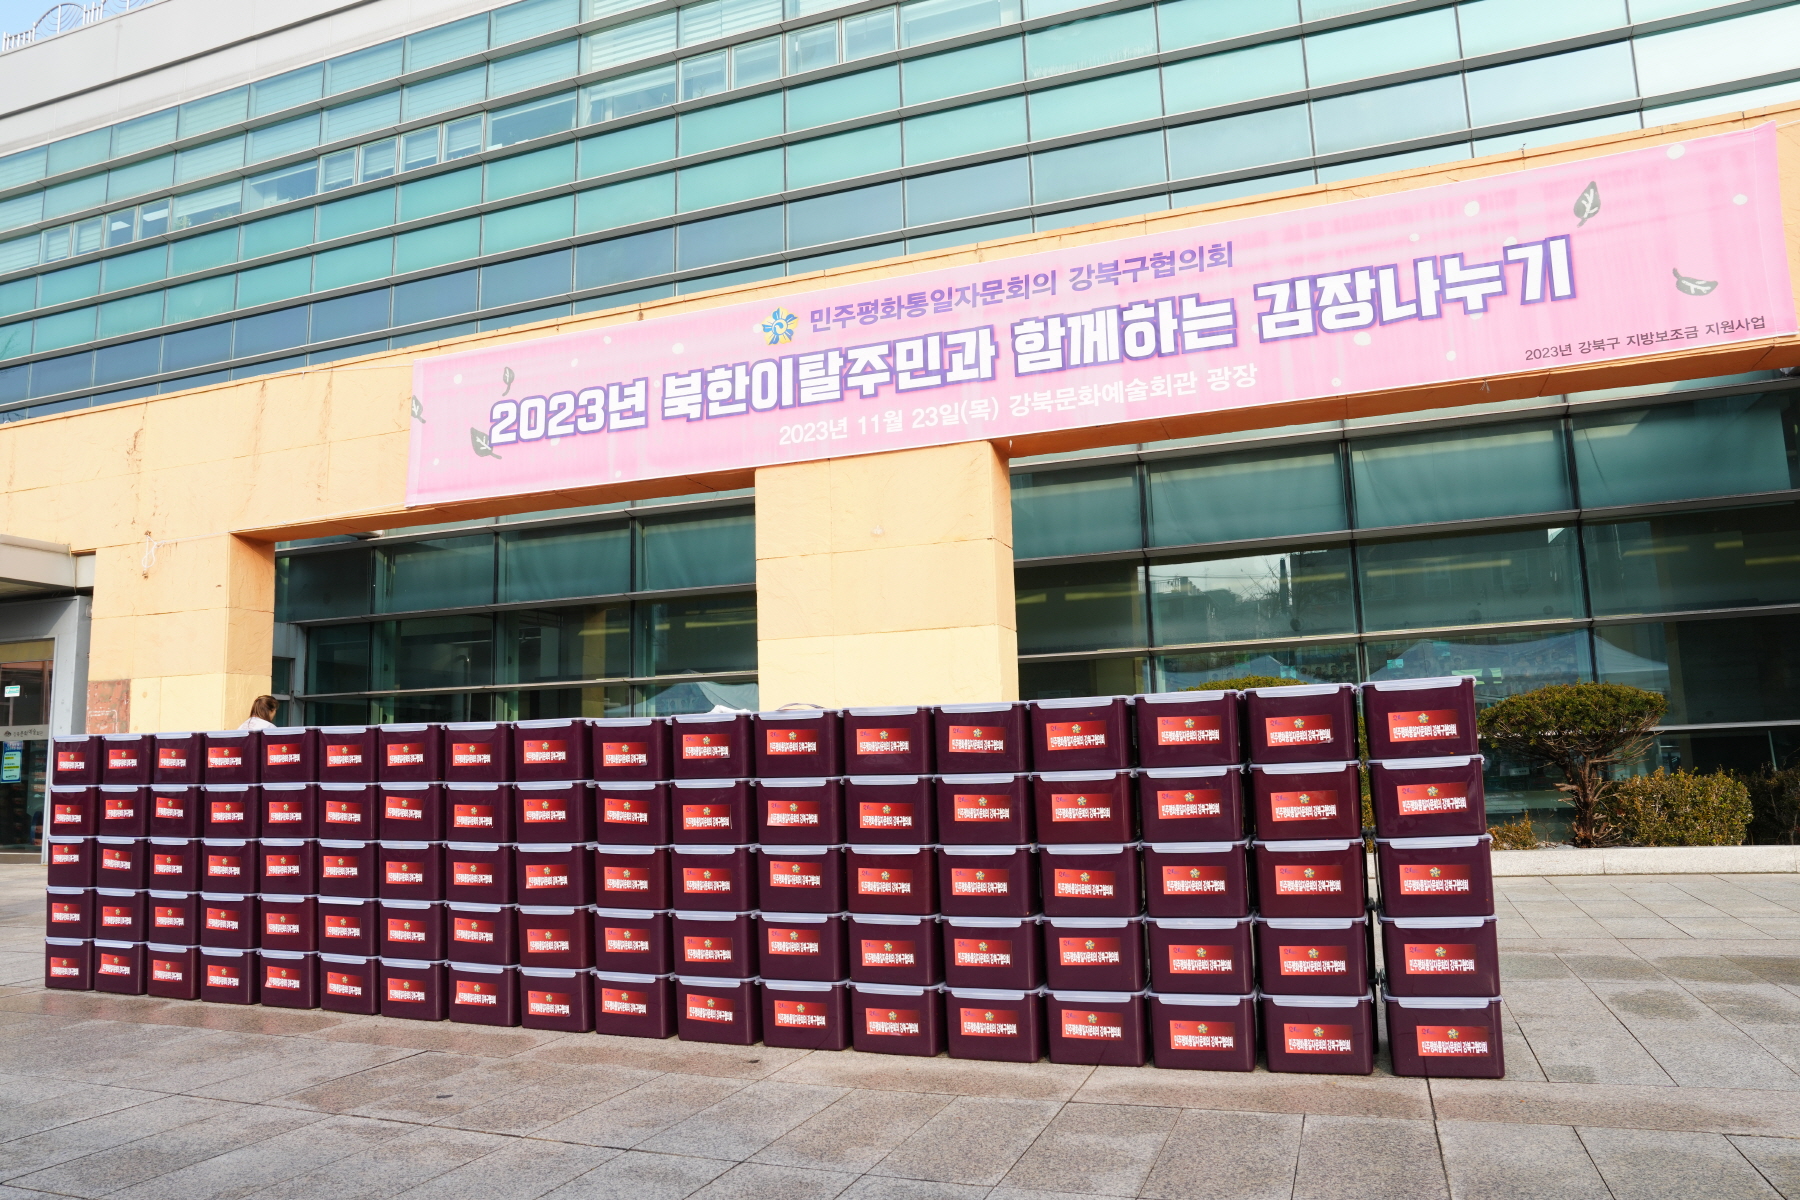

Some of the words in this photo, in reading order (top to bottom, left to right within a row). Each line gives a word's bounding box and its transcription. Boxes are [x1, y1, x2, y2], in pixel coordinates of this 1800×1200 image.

[810, 270, 1057, 332] 민주평화통일자문회의
[1069, 241, 1233, 291] 강북구협의회
[490, 377, 648, 447] 2023년
[661, 324, 996, 422] 북한이탈주민과
[1011, 293, 1237, 376] 함께하는
[1254, 234, 1576, 343] 김장나누기
[1525, 343, 1572, 361] 2023년
[1578, 337, 1621, 355] 강북구
[1626, 326, 1699, 348] 지방보조금
[1705, 316, 1766, 336] 지원사업
[779, 417, 848, 445] 2023년
[858, 410, 903, 435] 11월
[912, 397, 999, 429] 23일(목)
[1008, 371, 1198, 417] 강북문화예술회관
[1206, 363, 1258, 391] 광장
